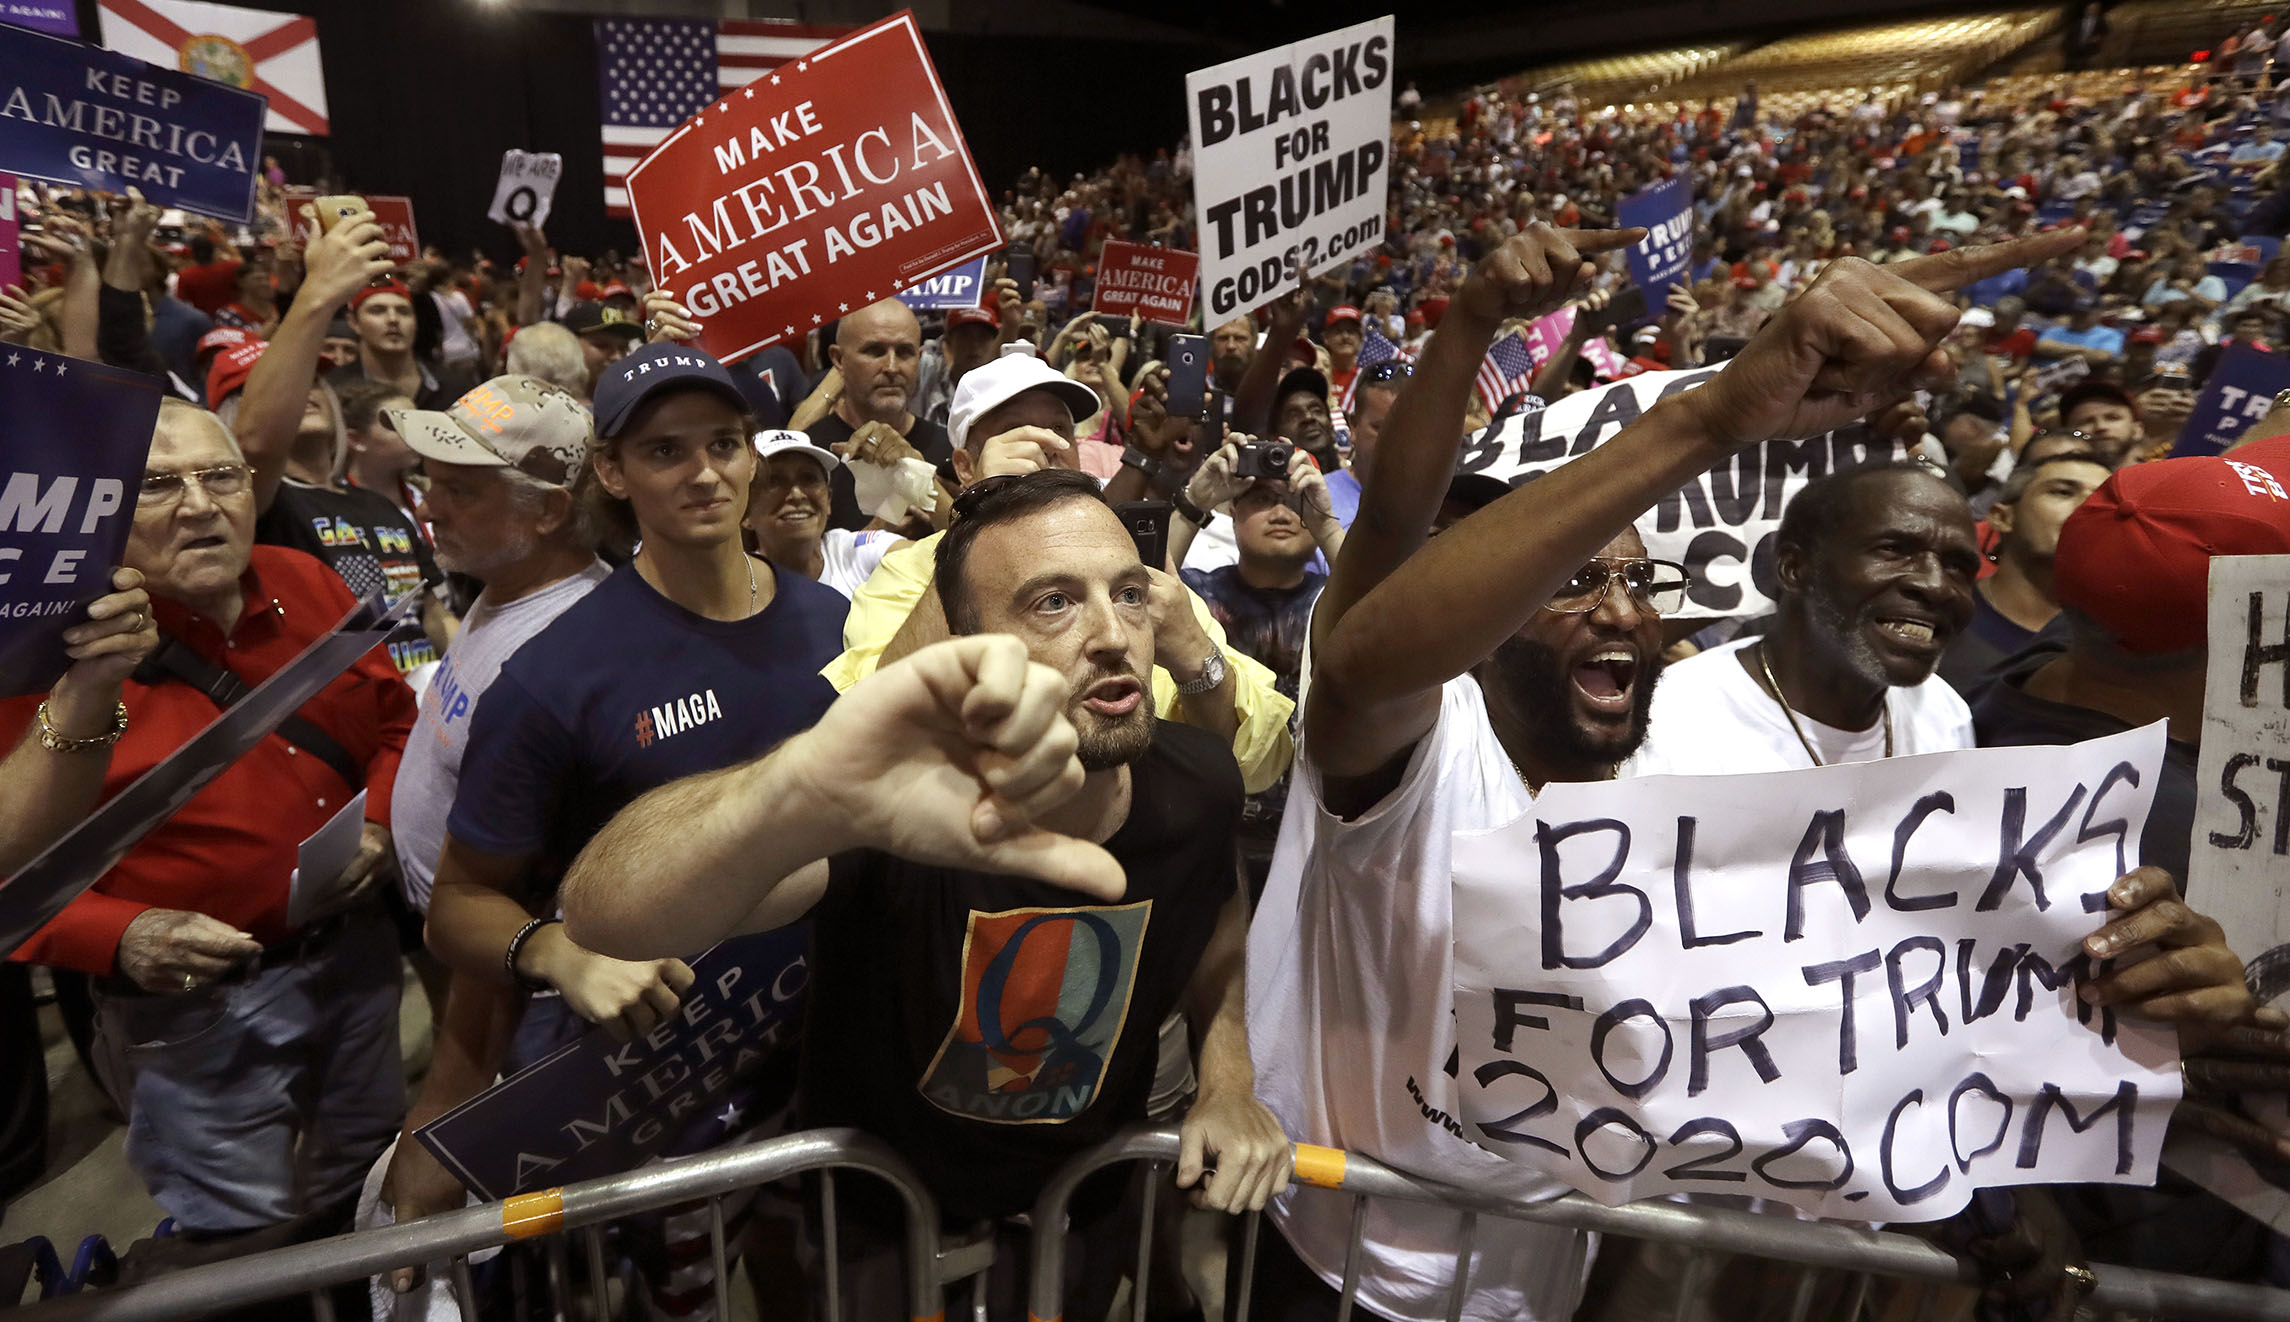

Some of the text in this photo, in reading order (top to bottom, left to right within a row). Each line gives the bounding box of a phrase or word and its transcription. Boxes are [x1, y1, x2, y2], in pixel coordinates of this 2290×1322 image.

[86, 67, 181, 110] KEEP
[1198, 35, 1388, 148] BLACKS
[1, 86, 248, 174] AMERICA
[69, 145, 186, 189] GREAT
[713, 100, 823, 175] MAKE
[1275, 119, 1330, 170] FOR
[658, 111, 954, 287] AMERICA
[1206, 139, 1384, 260] TRUMP
[685, 180, 953, 318] GREAT AGAIN
[1099, 268, 1190, 297] AMERICA
[1130, 255, 1165, 270] MAKE
[1211, 213, 1380, 315] GODS2.com
[1102, 289, 1182, 312] GREAT AGAIN
[624, 356, 706, 382] TRUMP
[0, 601, 75, 619] AGAIN!
[635, 689, 722, 749] #MAGA
[1535, 760, 2139, 970] BLACKS
[603, 966, 743, 1078] KEEP
[1493, 984, 1782, 1098] FOR
[512, 955, 810, 1195] AMERIC
[632, 1020, 780, 1145] GREAT
[930, 1084, 1092, 1119] ANON
